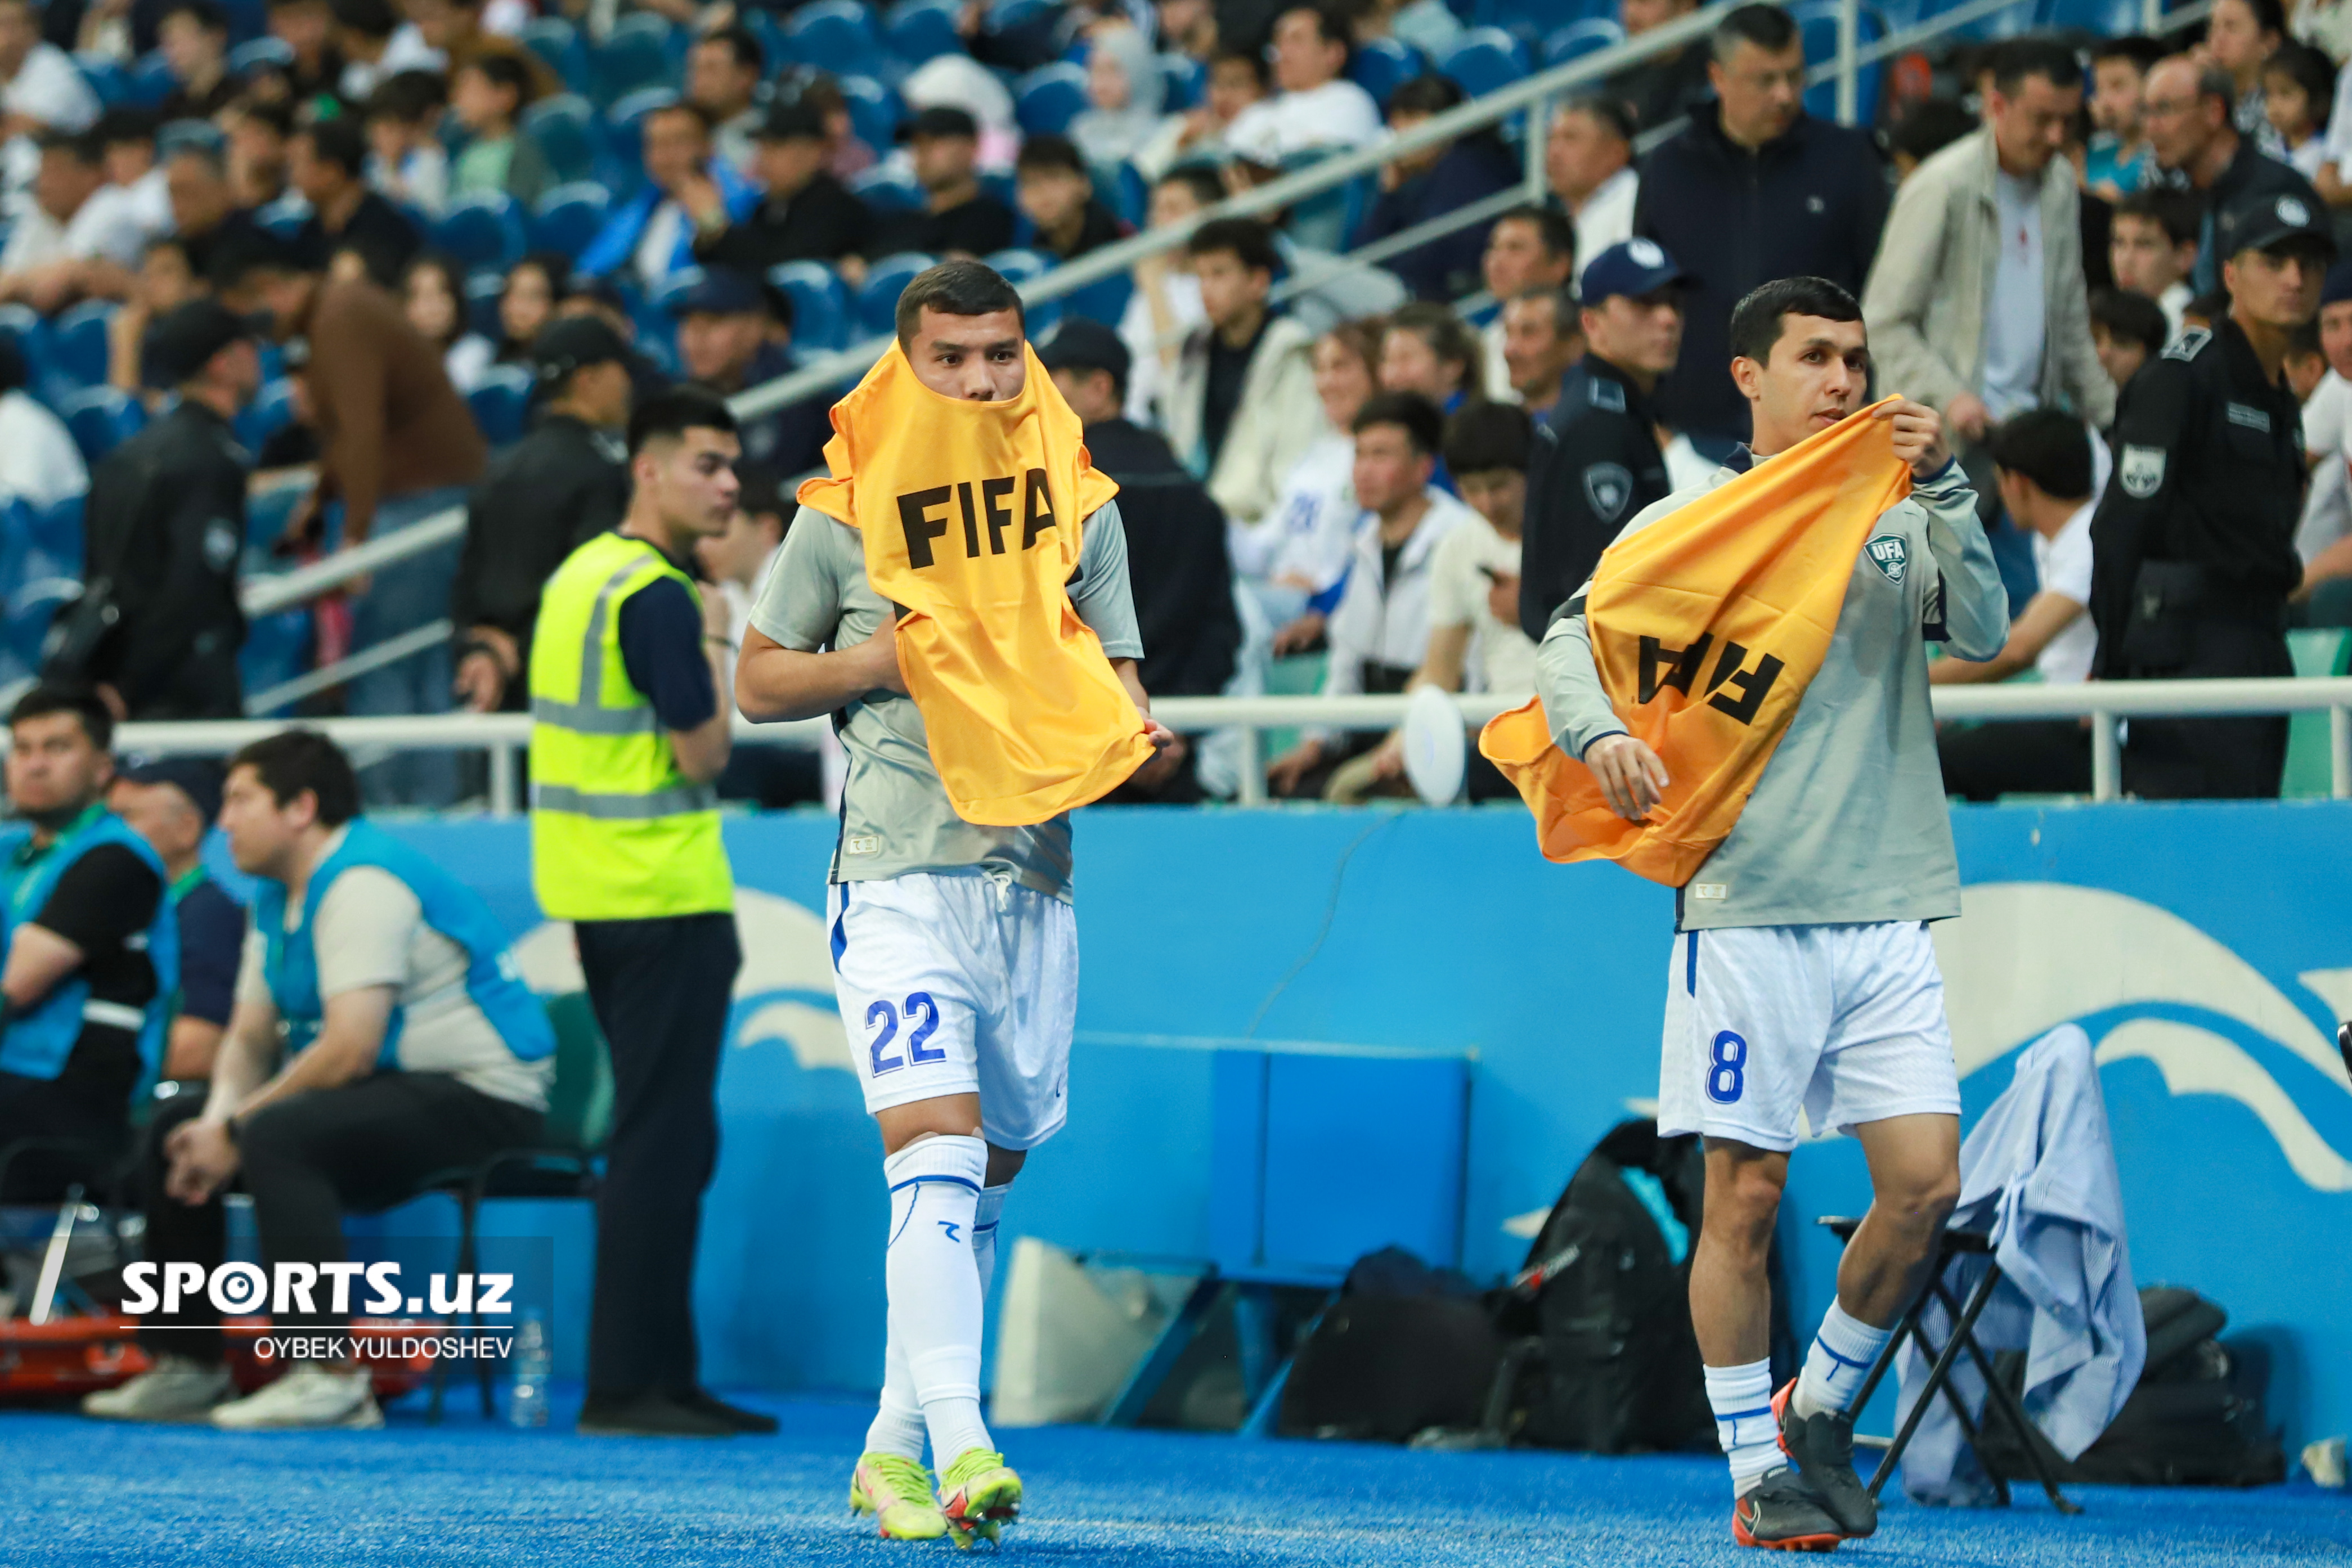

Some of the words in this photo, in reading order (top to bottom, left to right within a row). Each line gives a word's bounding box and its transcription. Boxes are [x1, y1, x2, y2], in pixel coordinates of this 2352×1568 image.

[897, 468, 1058, 569] FIFA
[1871, 541, 1905, 560] UFA
[864, 991, 946, 1079] 22
[1705, 1030, 1747, 1104] 8
